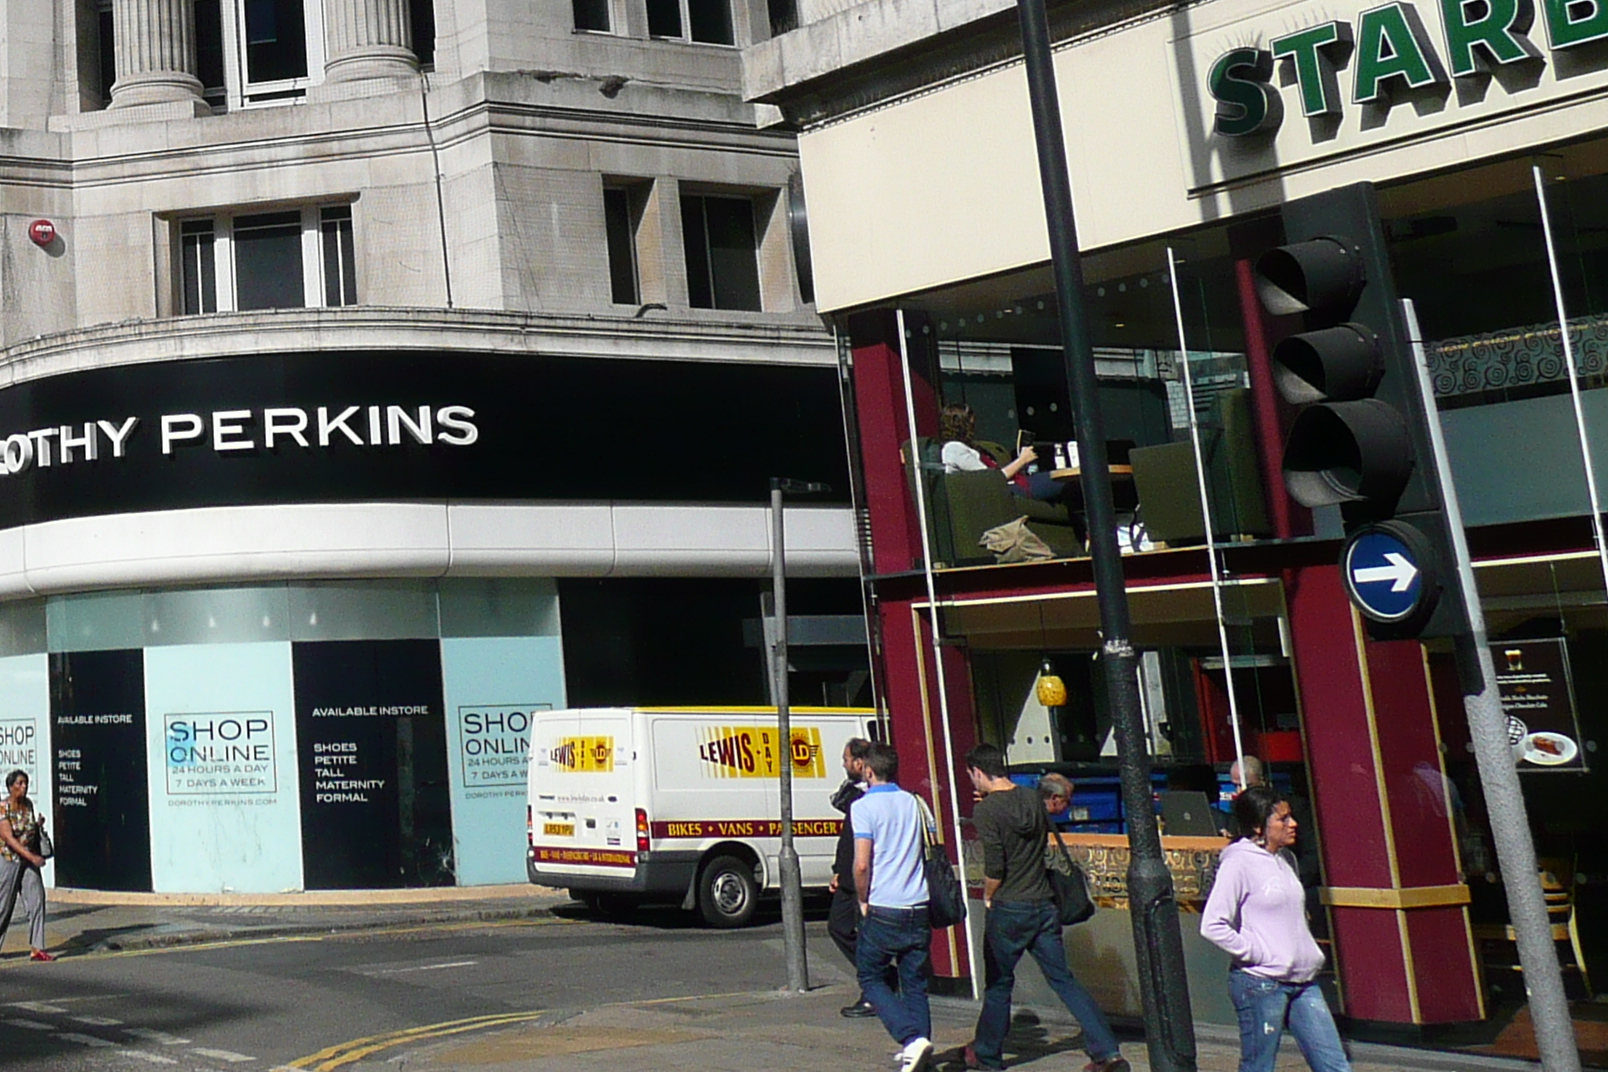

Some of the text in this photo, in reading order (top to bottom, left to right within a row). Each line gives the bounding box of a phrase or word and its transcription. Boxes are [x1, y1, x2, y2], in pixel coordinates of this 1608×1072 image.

[161, 405, 479, 455] PERKINS
[312, 705, 429, 717] AVAILABLE INSTORE
[57, 714, 133, 724] AVAILABLE INSTORE
[464, 711, 535, 734] SHO
[170, 719, 268, 741] SHOP
[313, 743, 358, 753] SHOES
[700, 732, 755, 773] LEWIS
[762, 732, 773, 773] DAY
[58, 749, 81, 758] SHOES
[170, 745, 270, 763] ONLINE
[550, 741, 576, 769] LEWIS
[314, 755, 358, 765] PETITE
[467, 758, 481, 767] 24
[482, 756, 520, 767] HOURS
[58, 761, 81, 770] PETITE
[172, 764, 268, 774] 24 HOURS A DAY
[58, 773, 74, 782] TALL
[314, 768, 345, 778] TALL
[472, 771, 478, 779] 7
[482, 770, 509, 780] DAYS
[510, 770, 518, 779] A
[175, 777, 266, 788] 7 DAYS A WEEK
[315, 780, 385, 790] MATERNITY
[59, 785, 98, 794] MATERNITY
[59, 797, 87, 806] FORMAL
[168, 798, 277, 807] DOROTHYPERKINS.COM
[316, 792, 369, 803] FORMAL
[668, 823, 703, 837] BIKES
[718, 823, 754, 836] VANS
[768, 822, 837, 836] PASENGER
